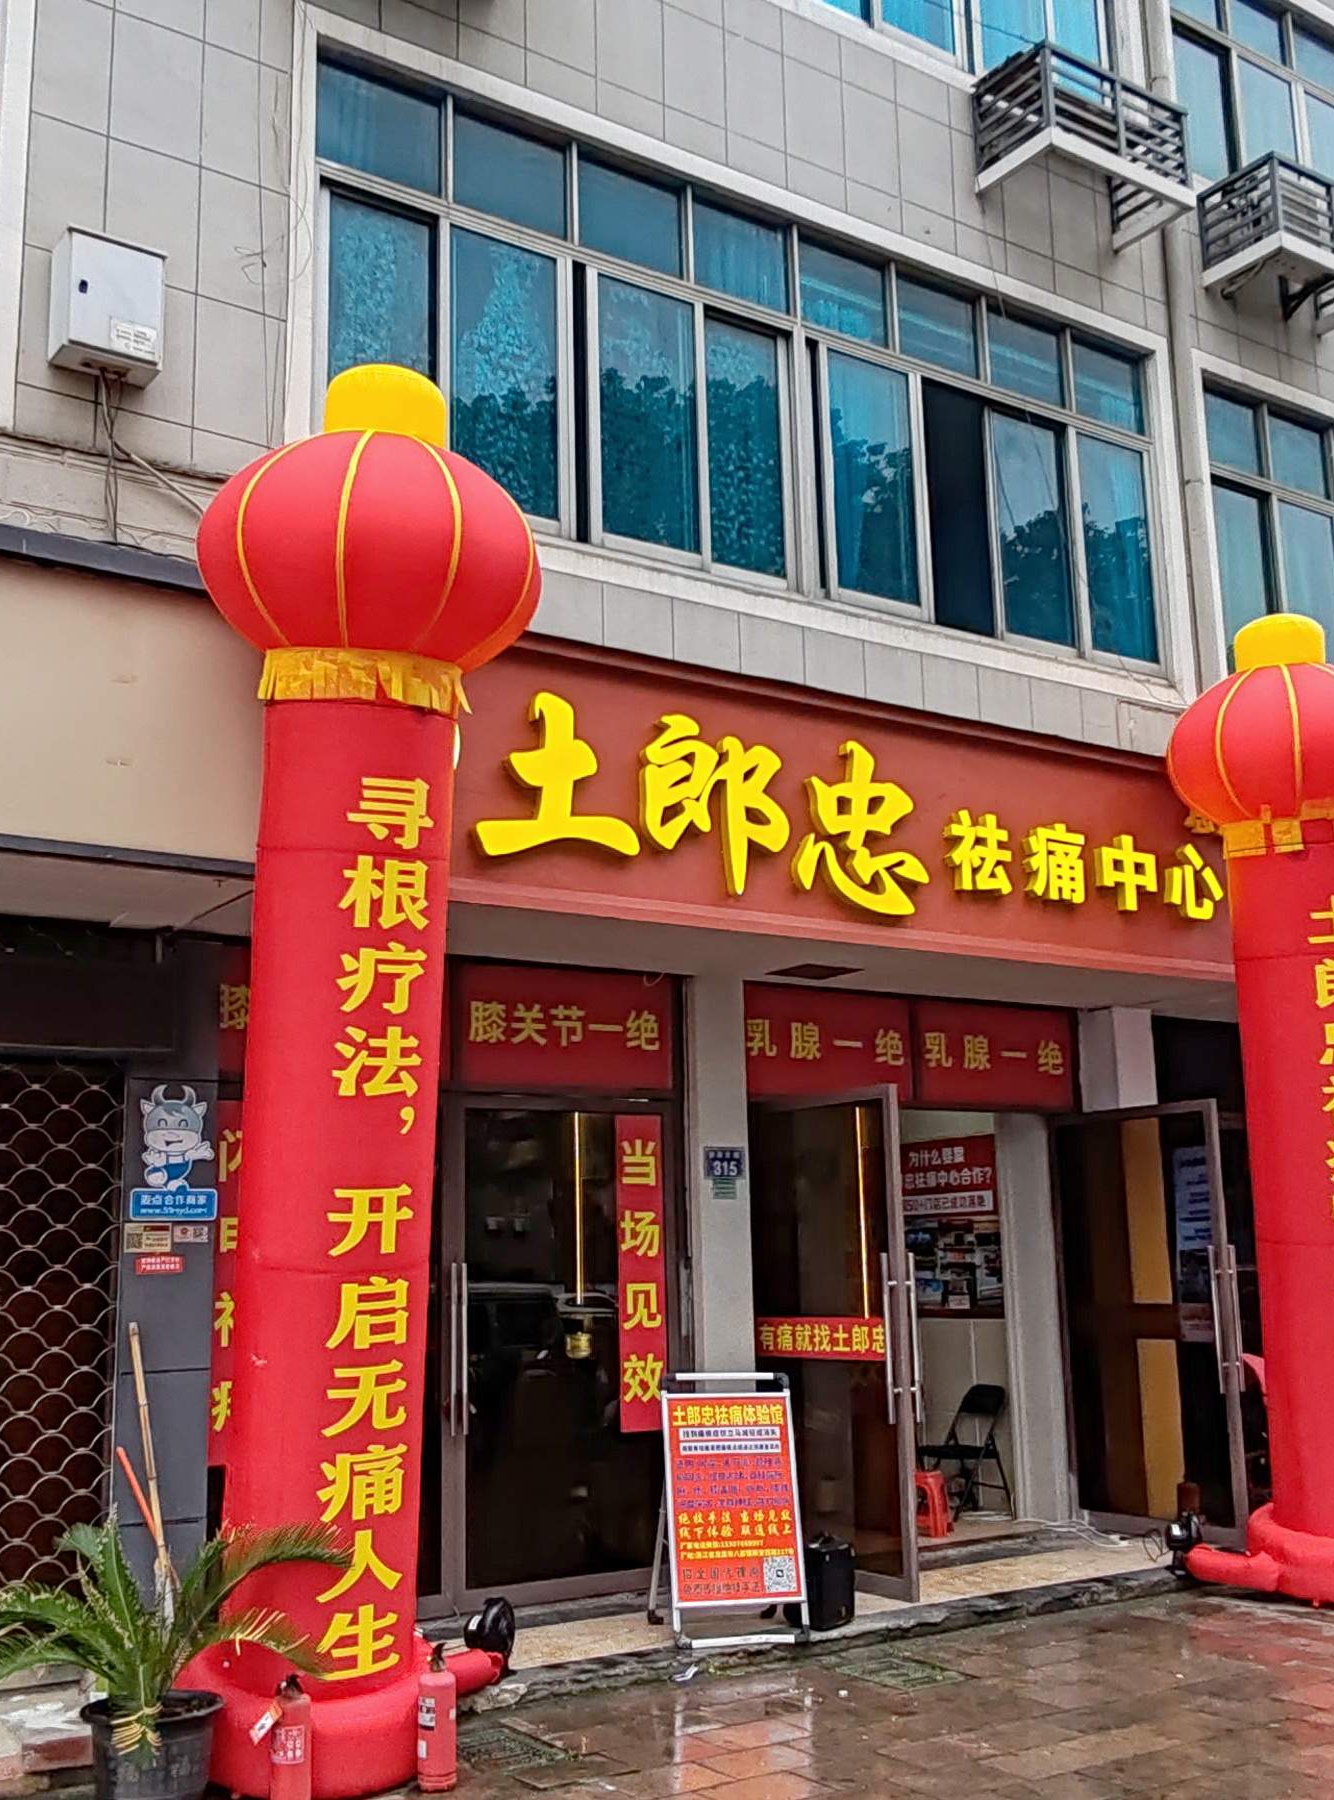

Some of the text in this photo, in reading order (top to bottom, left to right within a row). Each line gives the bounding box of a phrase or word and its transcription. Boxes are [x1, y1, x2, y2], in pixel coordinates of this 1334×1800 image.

[469, 1001, 661, 1052] 膝关节一绝
[746, 1018, 905, 1068] 乳腺一绝
[923, 1029, 1064, 1077] 乳腺一绝
[620, 1138, 664, 1403] 当场见效
[759, 1323, 886, 1354] 有痛就找土郎忠
[672, 1404, 785, 1427] 土郎忠祛痛体验馆
